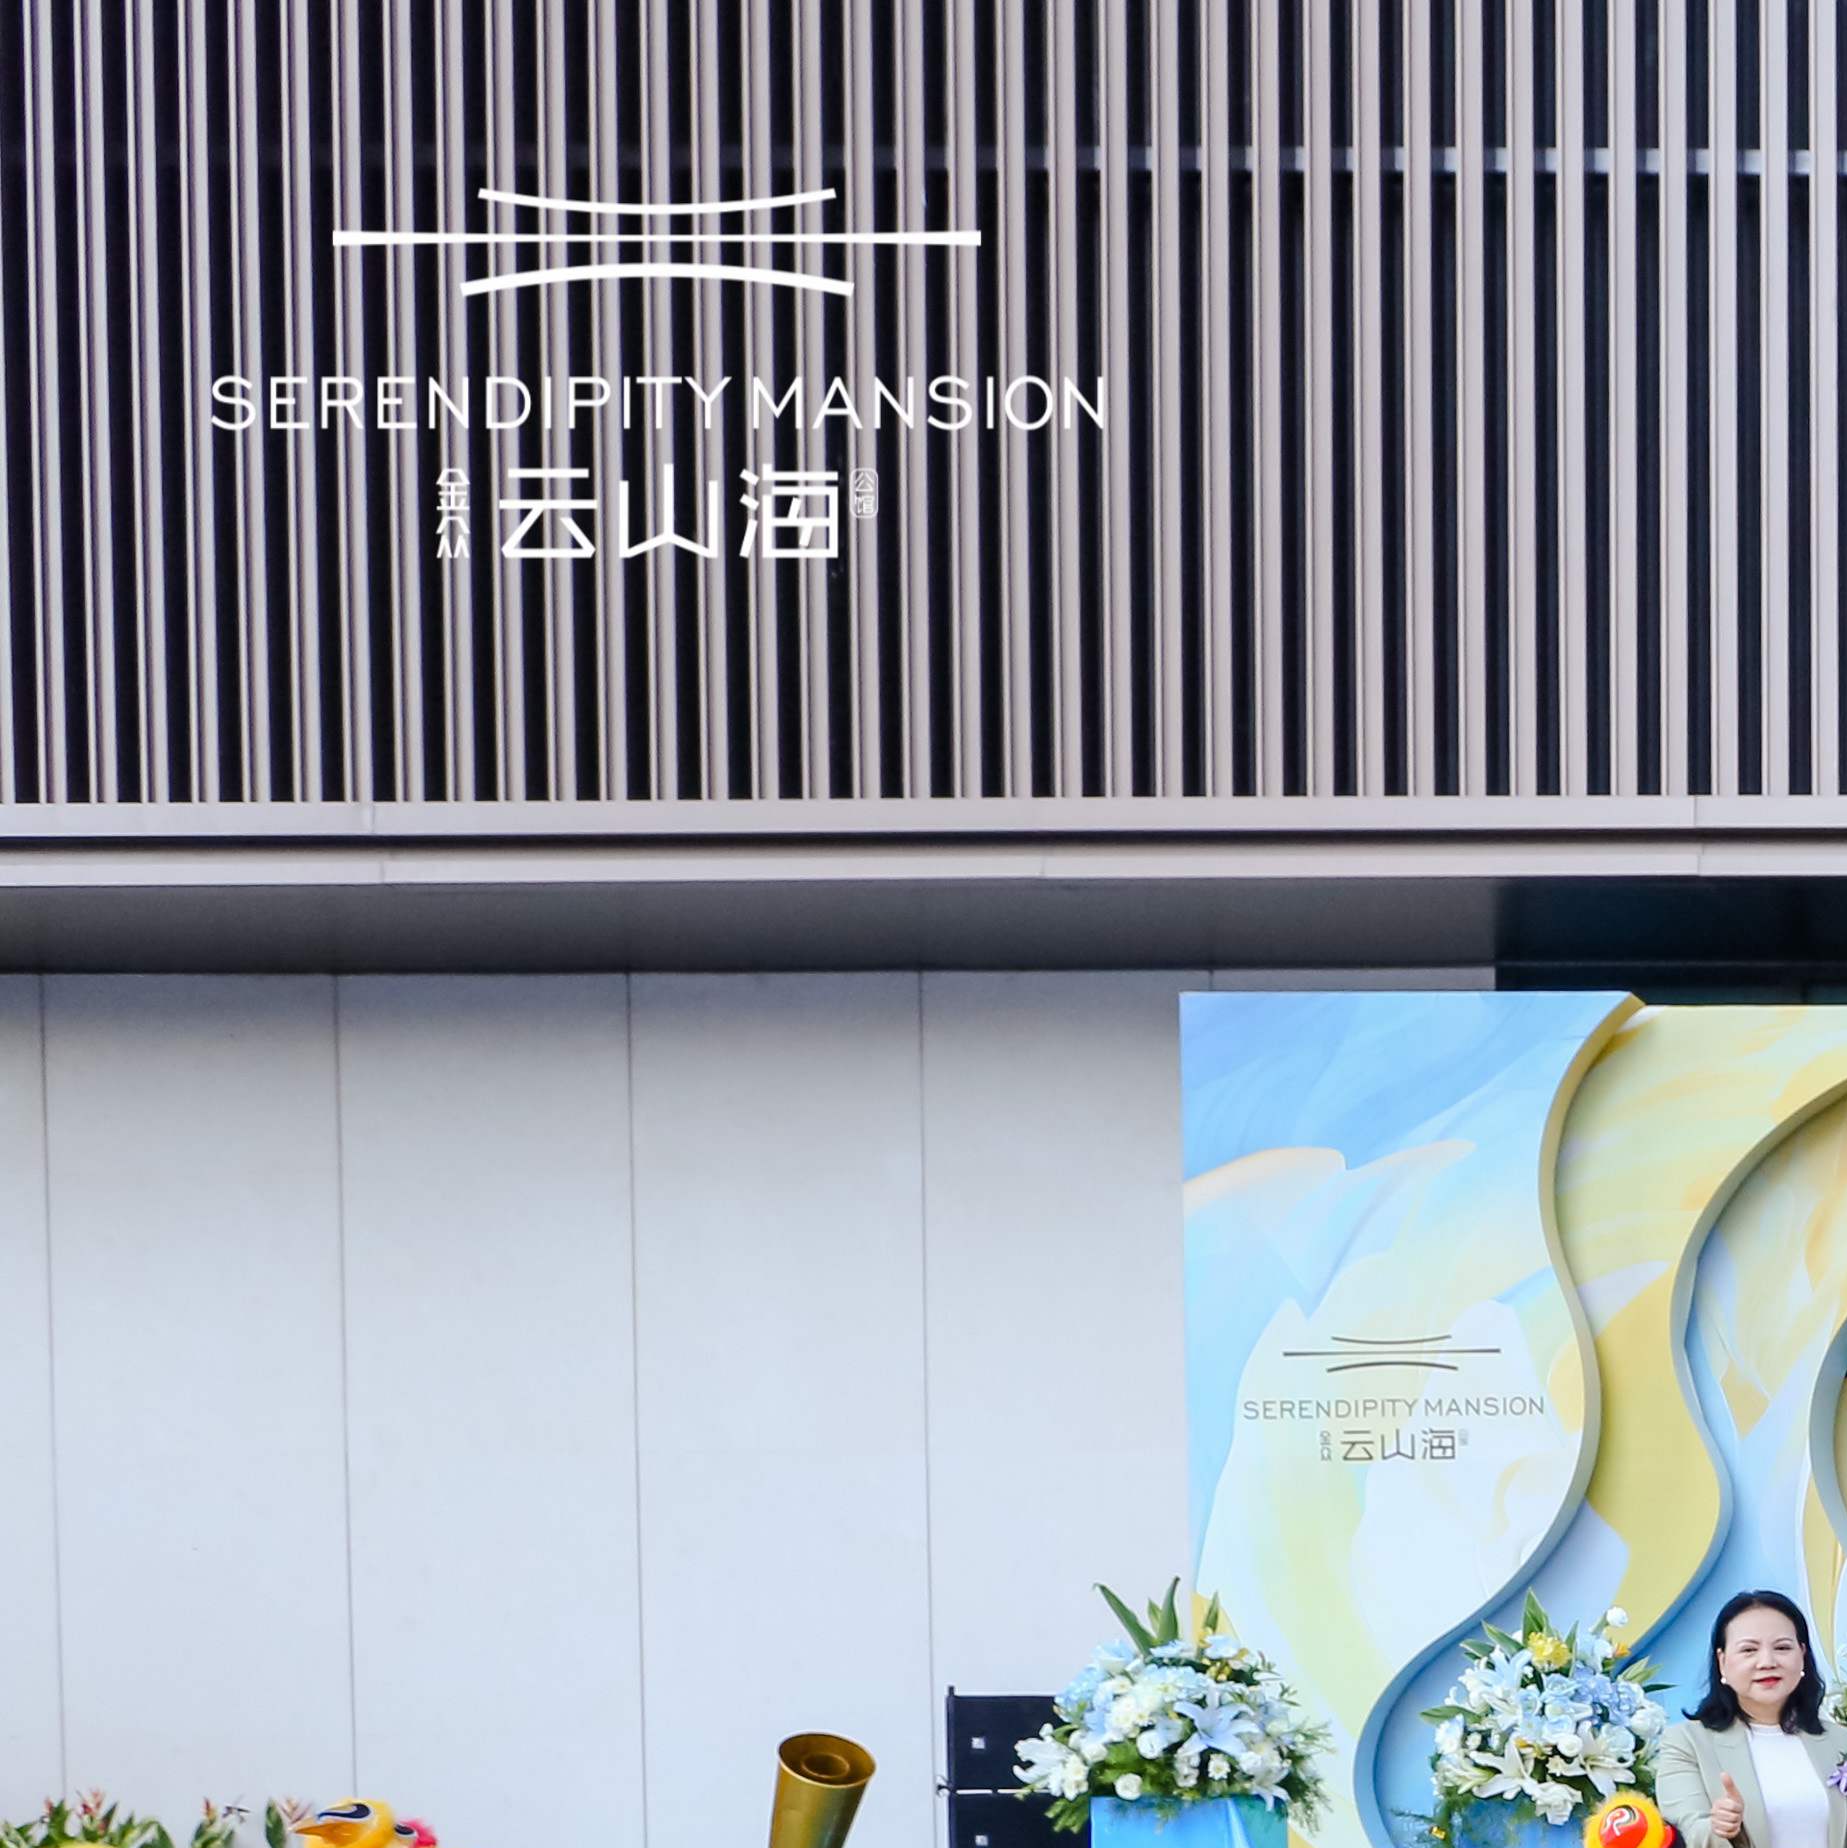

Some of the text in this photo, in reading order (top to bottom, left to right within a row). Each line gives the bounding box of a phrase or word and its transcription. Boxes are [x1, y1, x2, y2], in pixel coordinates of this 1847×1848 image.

[1243, 1395, 1545, 1421] SERENDIPITY MANSION
[1340, 1428, 1456, 1462] 云山海
